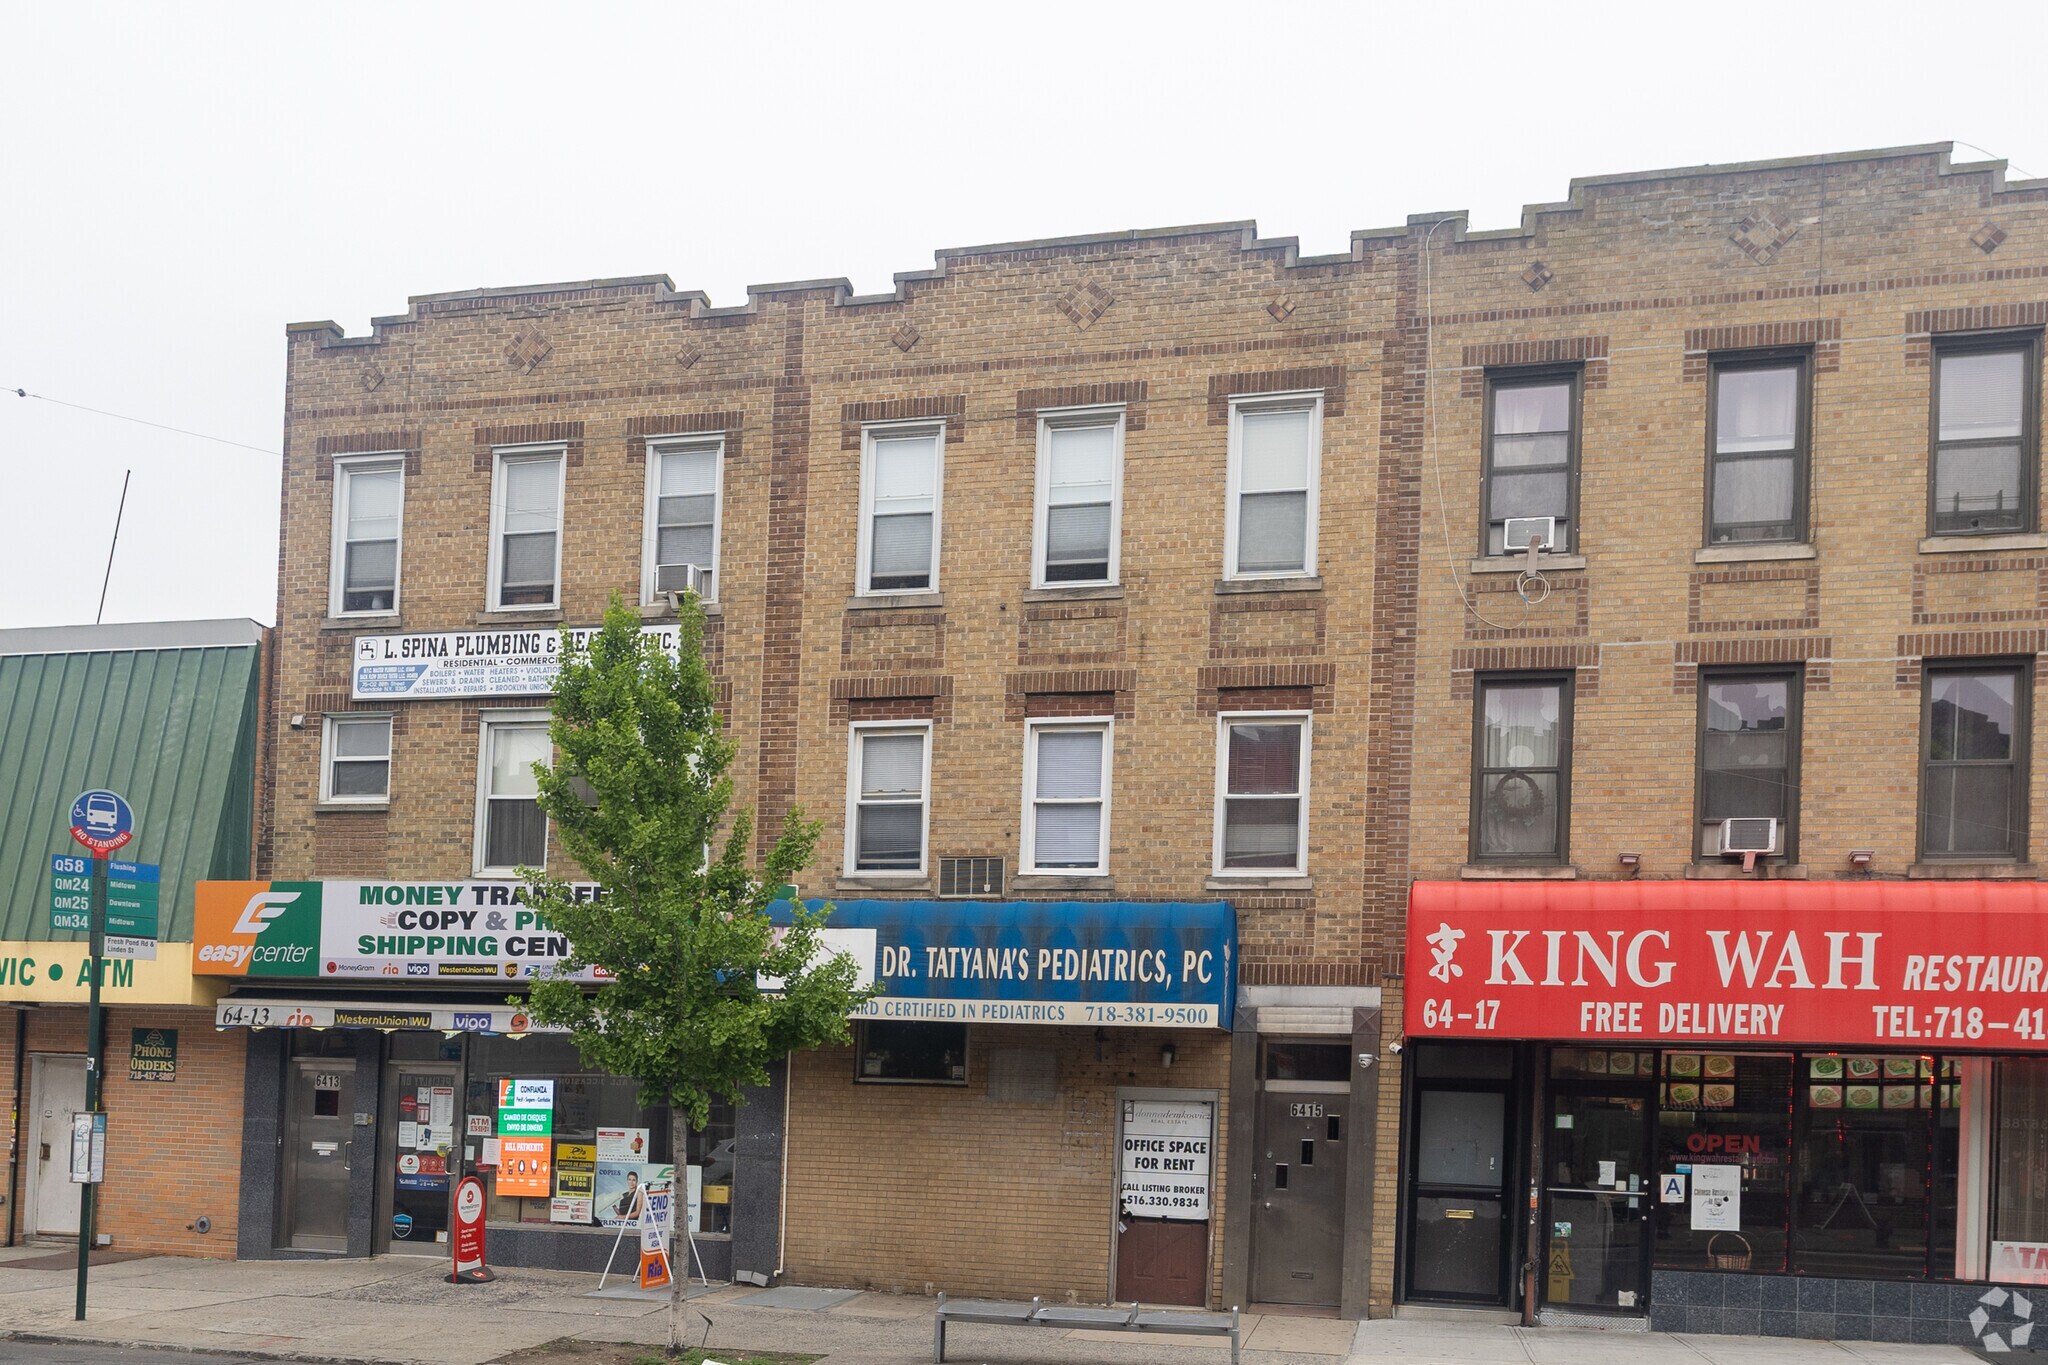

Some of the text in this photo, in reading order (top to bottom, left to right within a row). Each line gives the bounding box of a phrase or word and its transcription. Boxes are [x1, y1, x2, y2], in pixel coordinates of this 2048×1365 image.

[384, 640, 398, 658] L.
[402, 637, 448, 658] SPINA
[455, 634, 540, 656] PLUMBING
[444, 659, 498, 668] RESIDENTIAL
[75, 829, 128, 847] NO STANDING
[55, 858, 84, 873] Q58
[110, 862, 136, 873] Flushing
[55, 878, 89, 891] QM24
[110, 881, 136, 889] Midtown
[360, 886, 464, 905] MONEY
[54, 896, 89, 910] QM25
[109, 899, 140, 908] Downtown
[54, 914, 88, 928] QM34
[398, 911, 478, 930] COPY
[485, 911, 508, 931] &
[358, 935, 567, 956] SHIPPING CEN
[1484, 929, 2048, 993] KING WAH RESTAUR
[0, 958, 36, 986] IC
[383, 963, 398, 974] ria
[408, 964, 428, 974] vigo
[505, 967, 517, 975] ups
[882, 946, 1213, 991] DR. TATYANA'S PEDIATRICS, PC
[223, 1007, 269, 1024] 64-13
[885, 1002, 956, 1018] CERTIFIED
[962, 1004, 976, 1018] IN
[982, 1004, 1065, 1020] PEDIATRICS
[1085, 1006, 1208, 1024] 718-381-9500
[1423, 998, 1500, 1030] 64-17
[1581, 1002, 1785, 1035] FREE DELIVERY
[456, 1016, 489, 1030] vigo
[1872, 1005, 2048, 1040] TEL:718-41
[134, 1044, 172, 1057] PHONE
[131, 1058, 174, 1071] ORDERS
[316, 1075, 340, 1087] 6413
[1291, 1104, 1322, 1117] 6415
[528, 1114, 547, 1122] CHEQUES
[505, 1142, 544, 1152] BILL PAYMENTS
[1125, 1139, 1206, 1154] OFFICE SPACE
[1687, 1134, 1760, 1153] OPEN
[1135, 1157, 1195, 1171] FOR RENT
[1122, 1183, 1205, 1194] CALL LISTING BROKER
[1665, 1178, 1681, 1195] A
[1127, 1195, 1199, 1207] 516.330.9834
[647, 1258, 662, 1278] Ria
